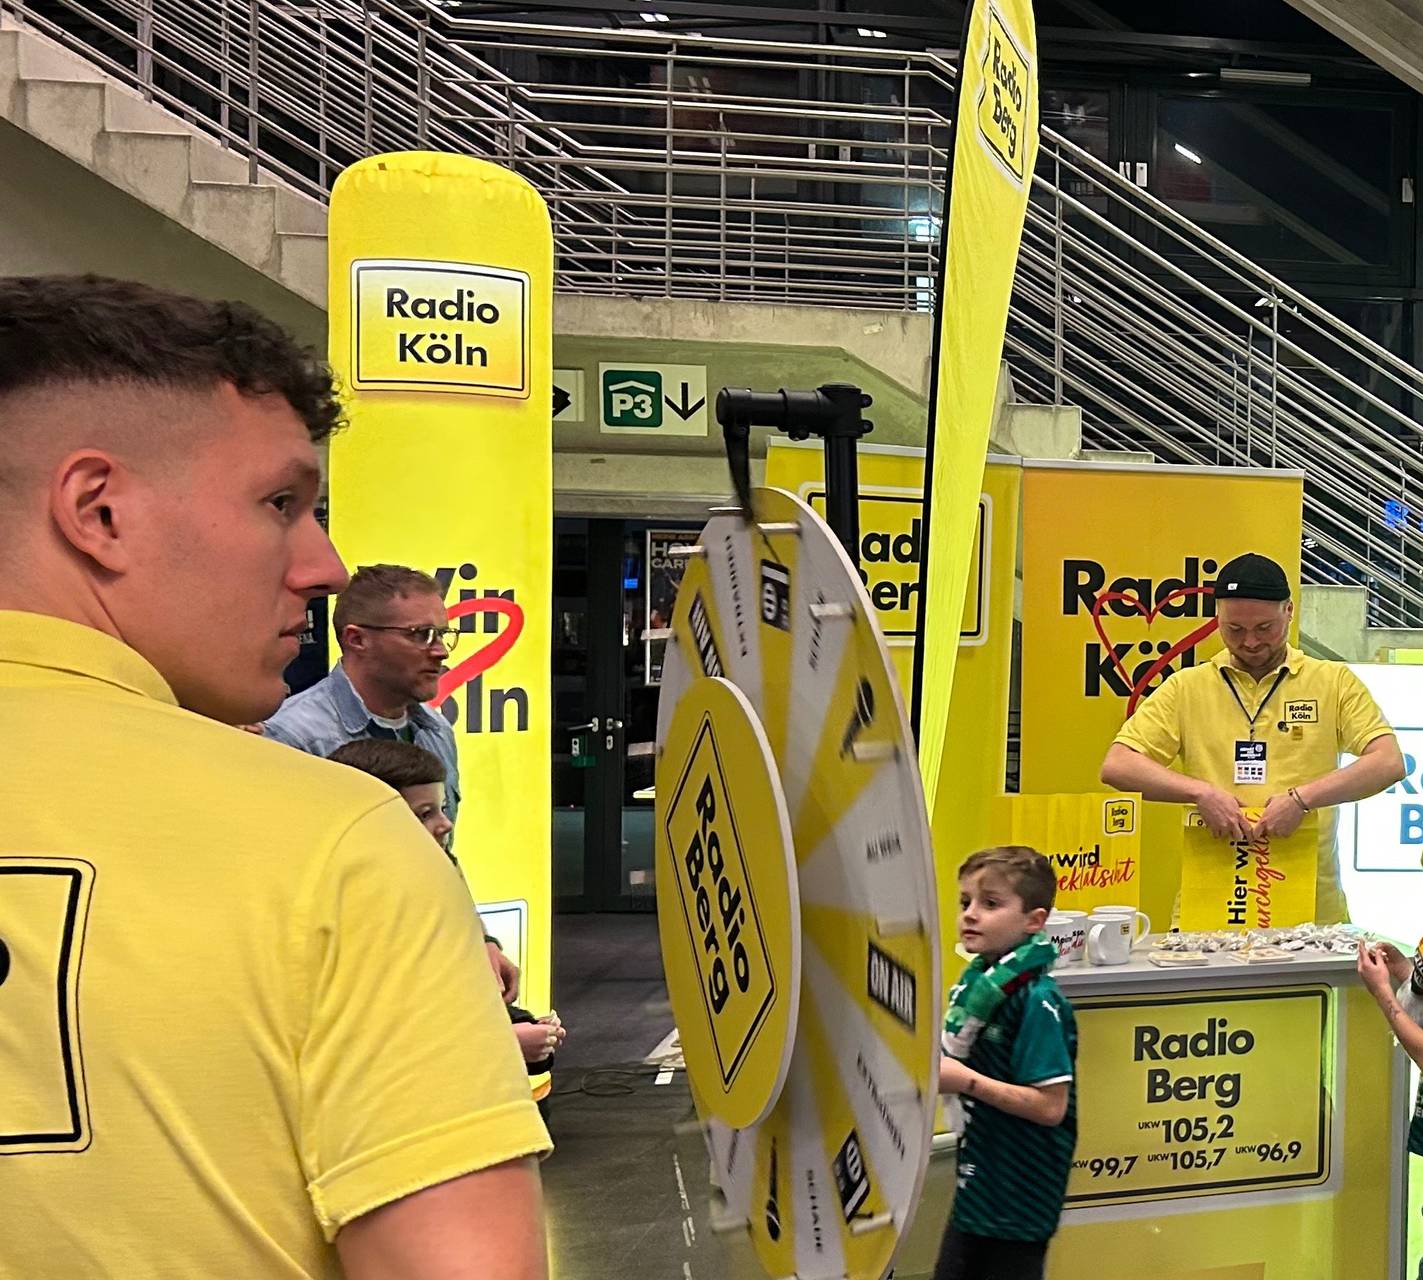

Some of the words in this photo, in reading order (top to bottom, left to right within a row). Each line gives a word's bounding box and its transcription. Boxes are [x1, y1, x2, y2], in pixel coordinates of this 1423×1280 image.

[993, 36, 1022, 112] Radio
[992, 83, 1017, 159] Berg
[386, 288, 500, 324] Radio
[399, 333, 488, 367] Köln
[612, 393, 653, 419] P3
[436, 563, 515, 633] ir
[1062, 557, 1218, 618] Radi
[1289, 704, 1313, 712] Radio
[1291, 712, 1311, 720] Köln
[1056, 844, 1100, 868] wird
[1230, 835, 1249, 870] wi
[696, 773, 750, 993] Radio
[1227, 875, 1248, 925] Hier
[685, 829, 730, 1014] Berg
[1133, 1018, 1255, 1062] Radio
[1146, 1068, 1242, 1109] Berg
[1138, 1120, 1160, 1130] UKW
[1161, 1114, 1234, 1144] 105,2
[1071, 1160, 1089, 1169] KW
[1089, 1155, 1138, 1178] 99,7
[1147, 1153, 1170, 1162] UKW
[1170, 1148, 1226, 1171] 105,7
[1235, 1144, 1257, 1154] UKW
[1256, 1141, 1302, 1163] 96,9
